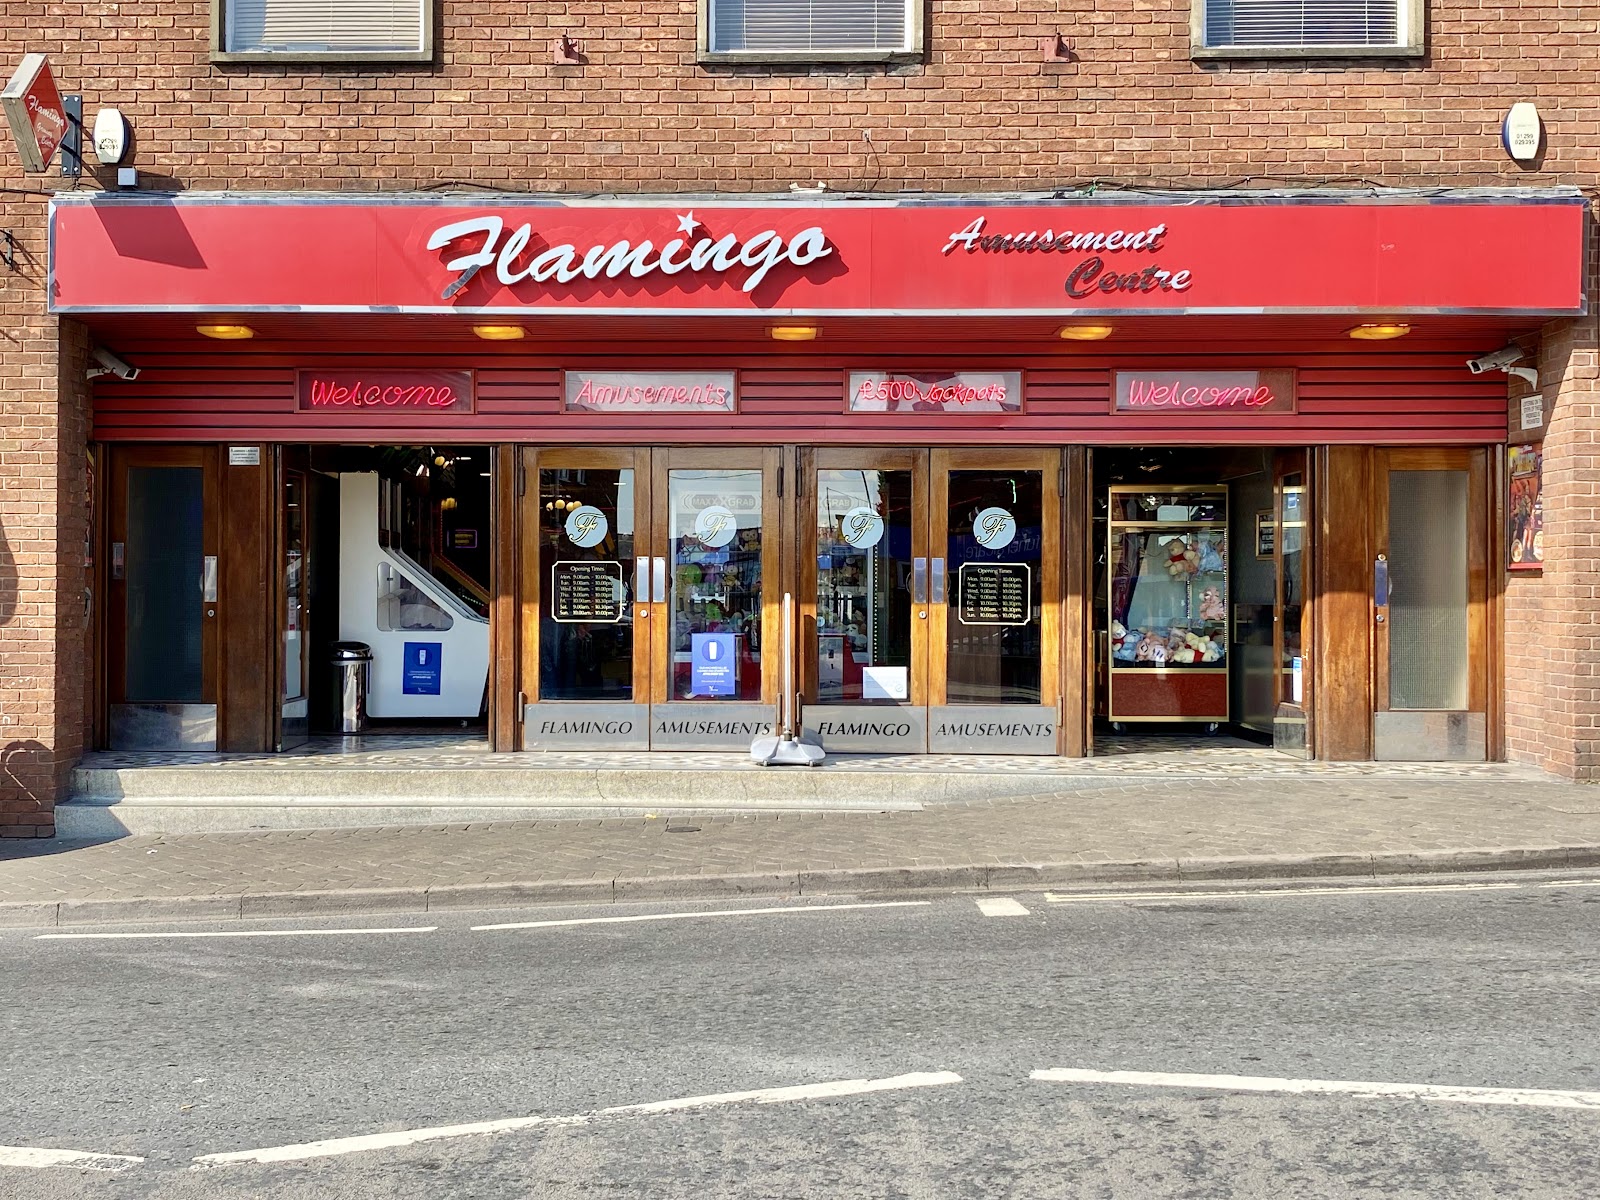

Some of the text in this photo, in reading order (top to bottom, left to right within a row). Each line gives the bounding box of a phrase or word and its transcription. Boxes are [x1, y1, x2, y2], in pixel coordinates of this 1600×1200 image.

[28, 94, 65, 128] Flamingo
[941, 215, 1166, 252] Amusement
[426, 210, 832, 300] Flamingo
[1063, 255, 1191, 297] Centre
[311, 379, 457, 406] Welcome
[574, 379, 727, 405] Amusements
[859, 379, 1007, 406] £500 Jackpots
[1129, 379, 1275, 407] Welcome
[728, 494, 754, 507] GRAB
[569, 565, 591, 573] Opening
[977, 567, 999, 575] Opening
[540, 720, 772, 736] FLAMINGO AMUSEMENTS
[817, 721, 1053, 737] FLAMINGO AMUSEMENTS
